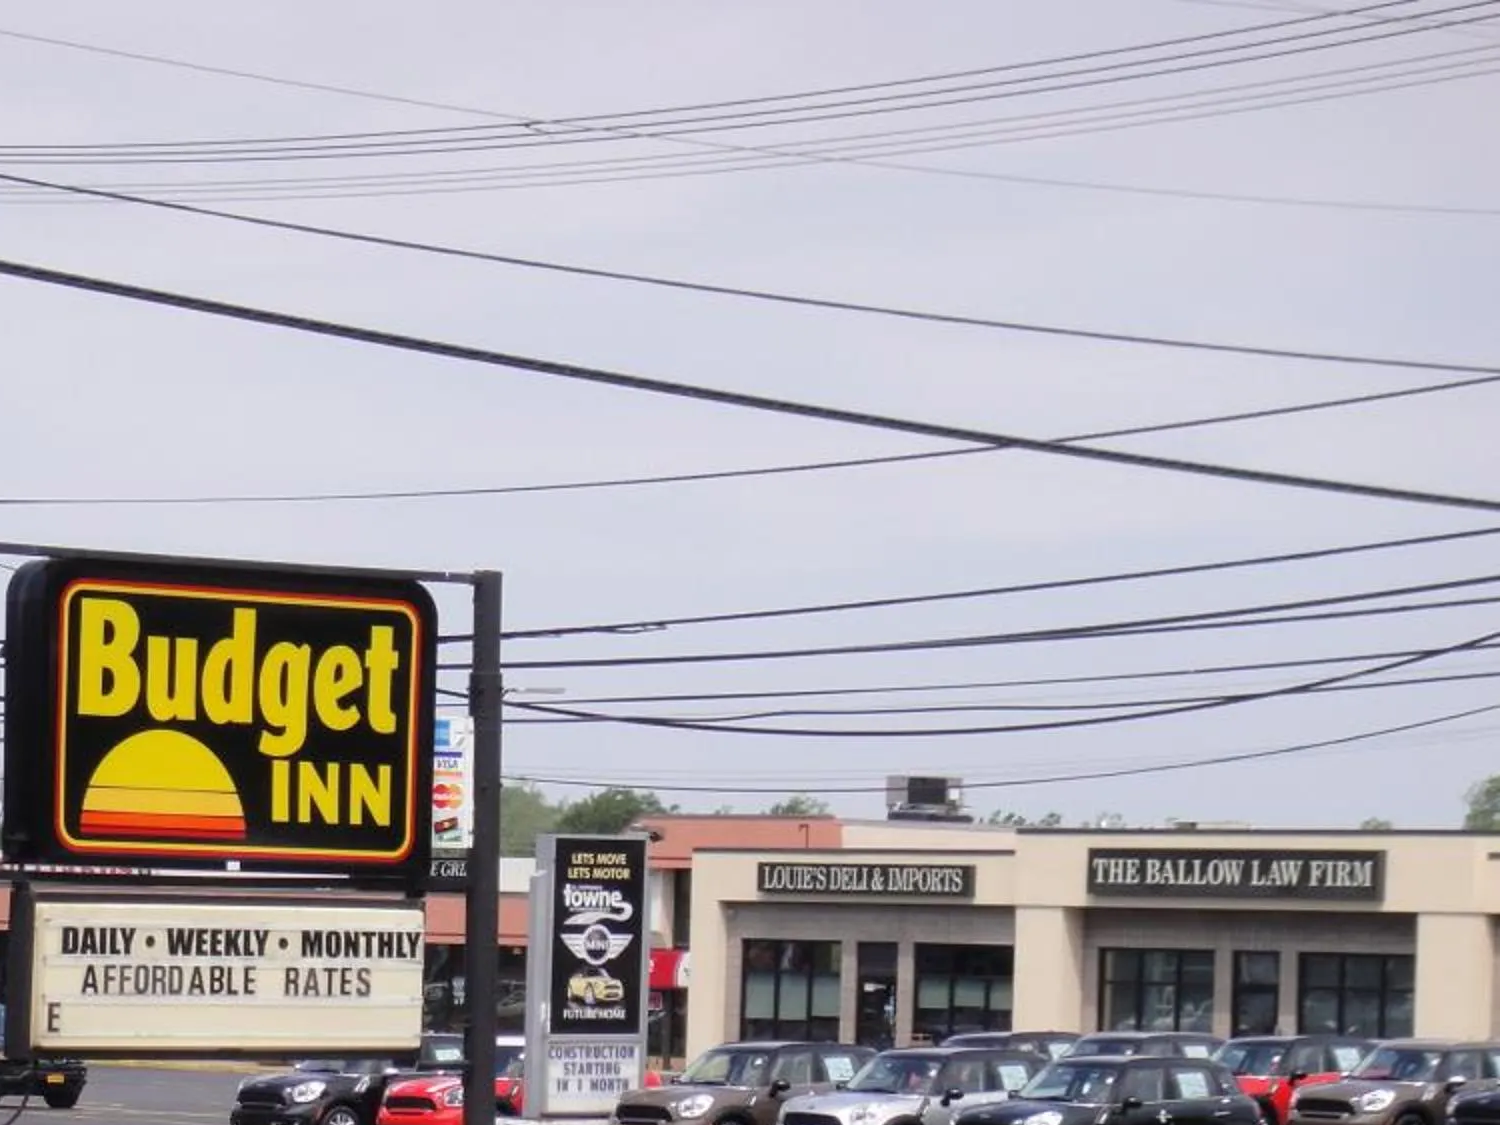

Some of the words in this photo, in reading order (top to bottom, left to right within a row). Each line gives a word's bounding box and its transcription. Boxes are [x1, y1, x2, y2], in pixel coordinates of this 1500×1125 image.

[77, 597, 399, 757] Budget
[271, 759, 391, 827] INN
[571, 853, 595, 865] LETS
[596, 853, 627, 865] MOVE
[1092, 858, 1140, 884] THE
[1145, 858, 1244, 886] BALLOW
[1250, 860, 1303, 887] LAW
[1308, 861, 1373, 888] FIRM
[567, 867, 590, 879] LETS
[592, 867, 631, 880] MOTOR
[764, 865, 827, 890] LOUIE'S
[830, 866, 869, 891] DELI
[871, 867, 885, 891] &
[887, 867, 963, 893] IMPORTS
[563, 883, 623, 908] towne
[61, 926, 137, 956] DAILY
[167, 927, 271, 958] WEEKLY
[301, 930, 422, 960] MONTHLY
[81, 964, 257, 996] AFFORDABLE
[284, 967, 372, 998] RATES
[47, 1002, 61, 1033] E
[548, 1045, 635, 1059] CONSTRUCTION
[563, 1062, 621, 1076] STARTING
[557, 1078, 569, 1092] IN
[590, 1078, 629, 1092] MONTH
